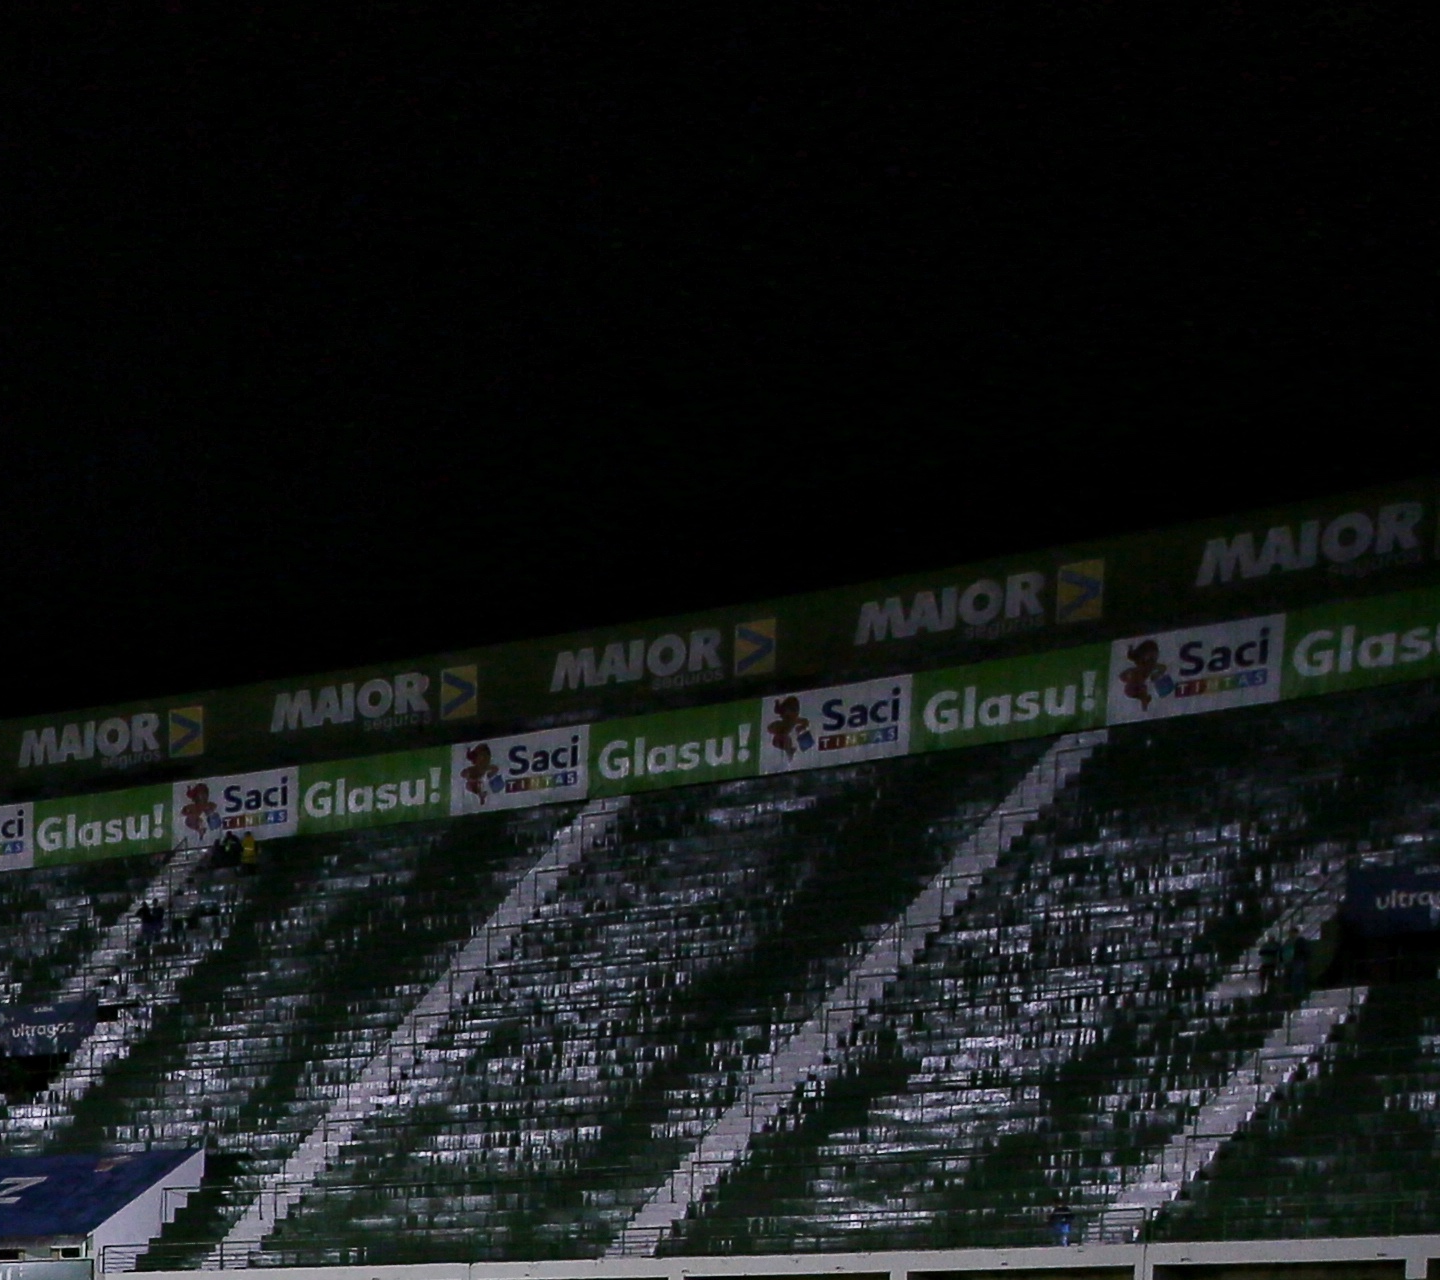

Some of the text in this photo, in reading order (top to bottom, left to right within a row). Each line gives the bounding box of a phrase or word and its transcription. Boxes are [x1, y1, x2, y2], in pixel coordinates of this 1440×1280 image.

[1196, 502, 1424, 587] MAIOR
[853, 571, 1045, 646] MAIOR
[550, 629, 721, 692] MAIOR
[1180, 627, 1270, 676] Saci
[1293, 622, 1440, 677] Glas
[270, 672, 430, 733] MAIOR
[822, 687, 901, 730] Saci
[923, 670, 1097, 734] Glasu!
[18, 713, 160, 768] MAIOR
[508, 735, 579, 775] Saci
[599, 724, 750, 780] Glasu!
[224, 777, 288, 812] Saci
[304, 767, 441, 819] Glasu!
[37, 804, 164, 851] Glasu!
